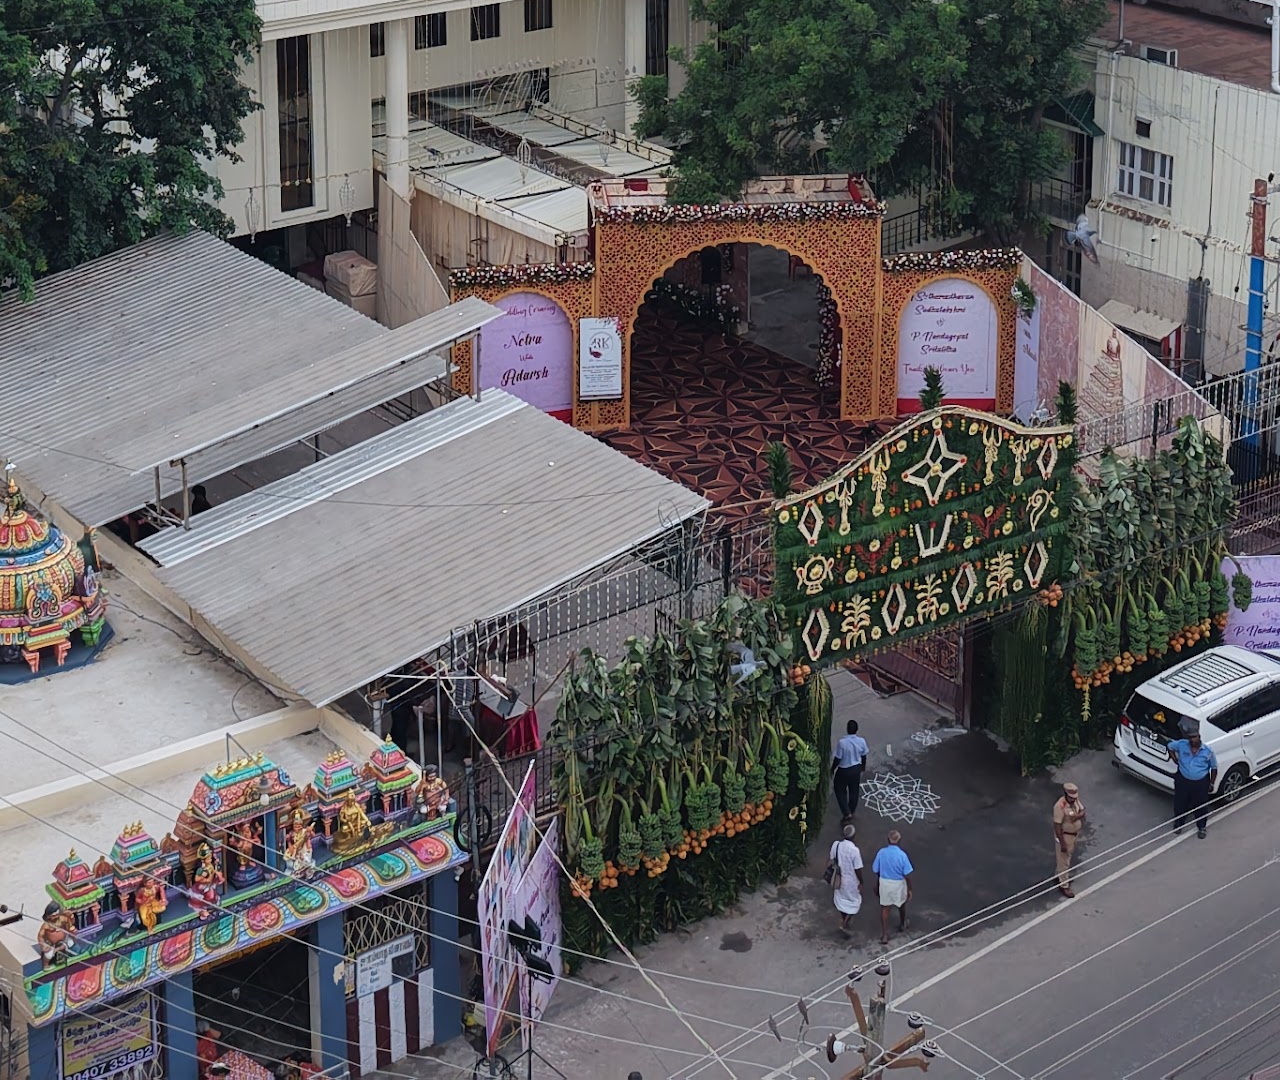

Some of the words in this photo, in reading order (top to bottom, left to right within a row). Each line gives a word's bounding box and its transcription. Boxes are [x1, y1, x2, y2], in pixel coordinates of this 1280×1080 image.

[503, 331, 544, 349] Netra
[500, 366, 550, 387] Adarsh
[109, 1045, 153, 1070] 33892
